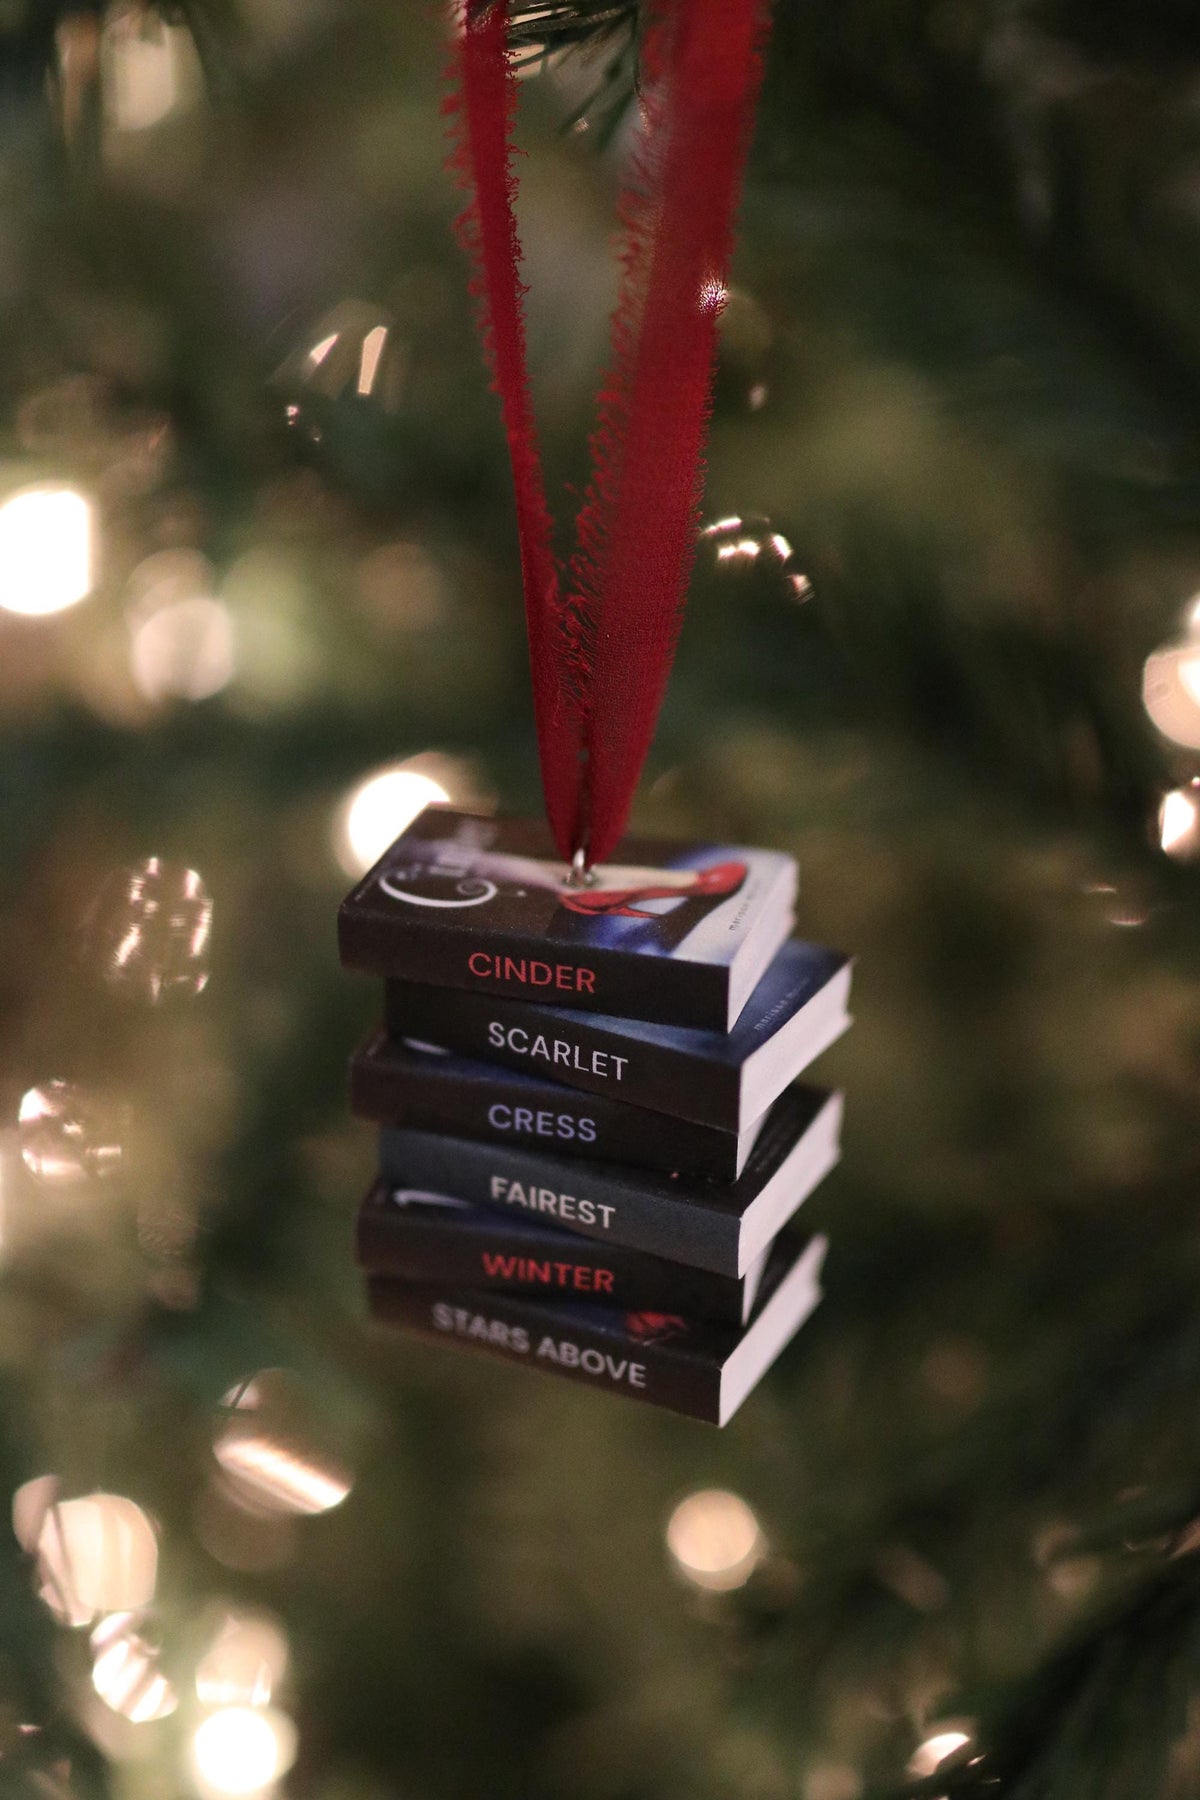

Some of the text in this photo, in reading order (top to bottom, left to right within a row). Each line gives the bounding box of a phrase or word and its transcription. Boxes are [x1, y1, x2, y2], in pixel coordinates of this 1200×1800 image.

[468, 951, 597, 994] CINDER
[488, 1021, 629, 1081] SCARLET
[488, 1103, 598, 1143] CRESS
[490, 1175, 616, 1229] FAIREST
[483, 1252, 615, 1293] WINTER
[432, 1302, 647, 1389] STARS ABOVE
